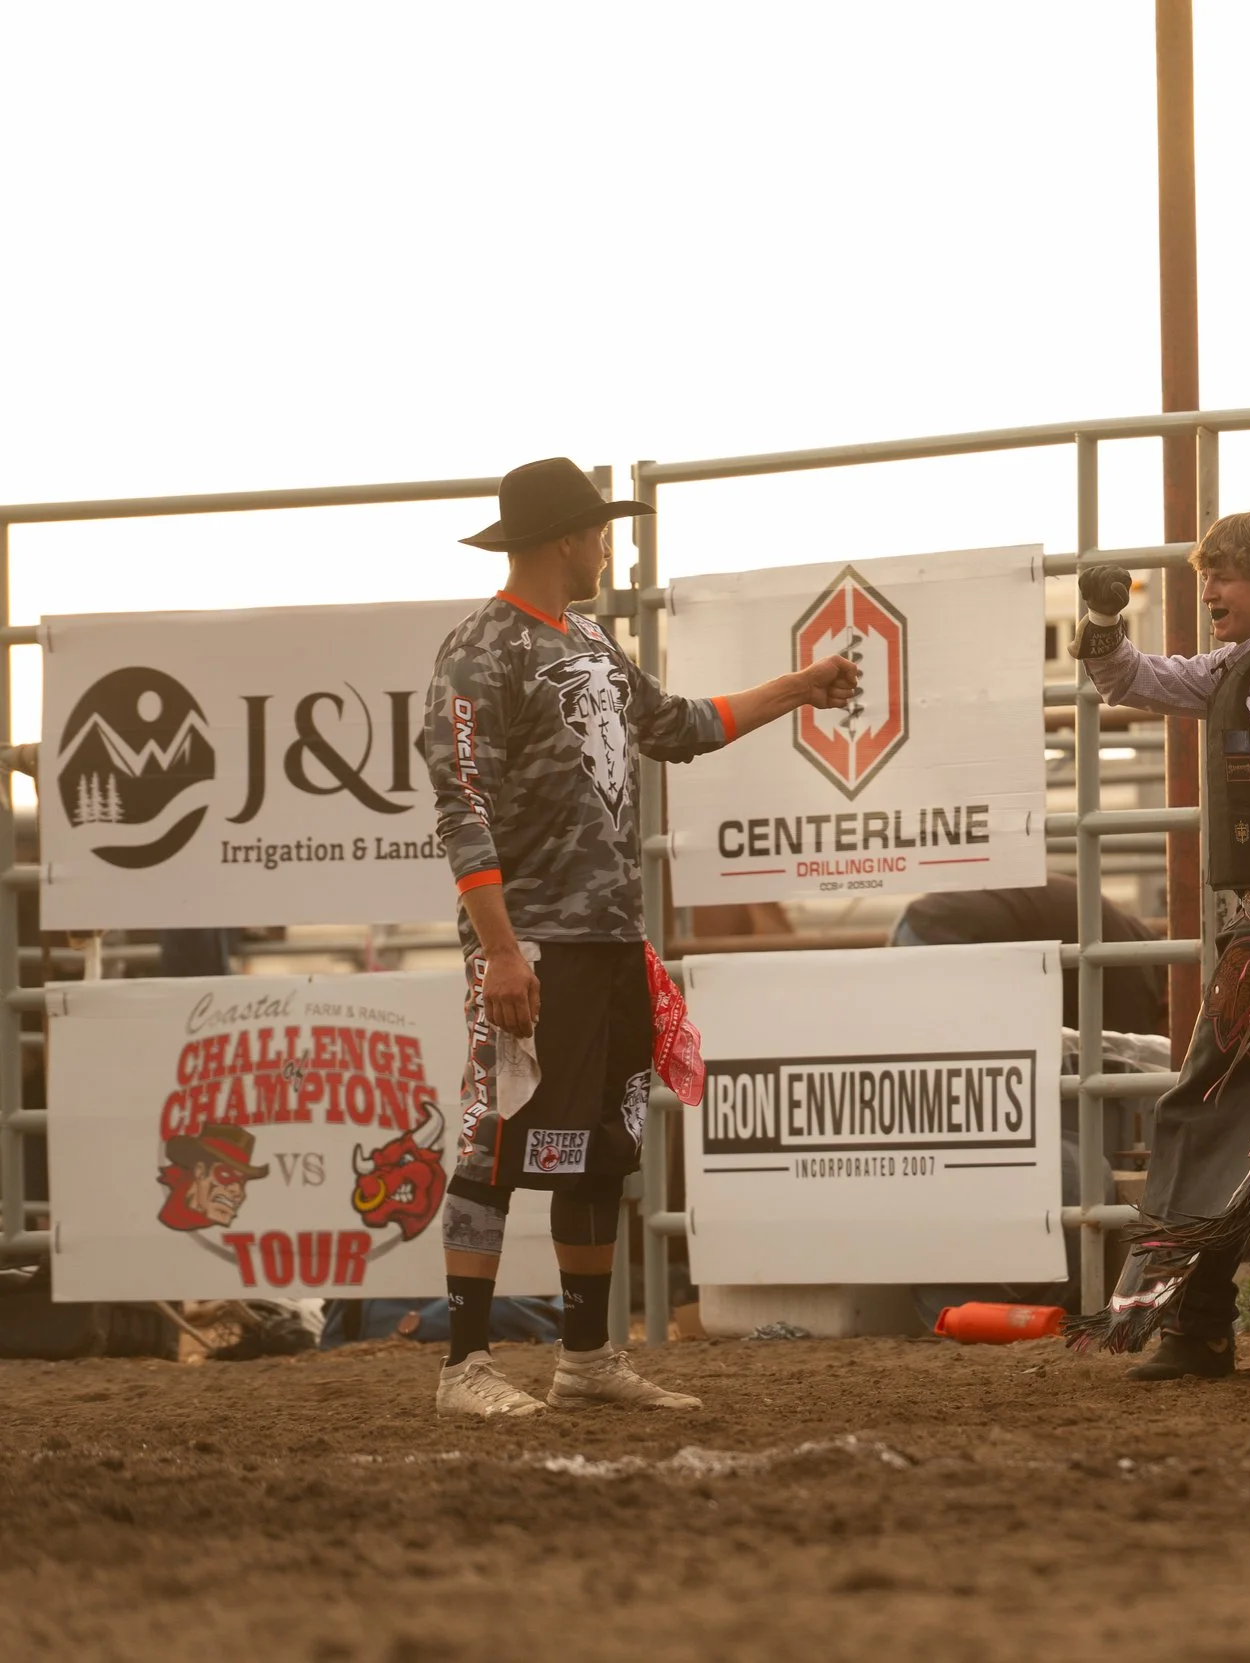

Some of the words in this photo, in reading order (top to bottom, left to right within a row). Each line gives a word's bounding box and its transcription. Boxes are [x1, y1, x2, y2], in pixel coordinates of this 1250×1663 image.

[577, 688, 624, 719] O'NEIL
[454, 697, 479, 783] O'NEIL
[222, 837, 344, 870] Irrigation
[352, 838, 368, 861] &
[718, 804, 989, 859] CENTERLINE
[796, 859, 874, 878] DRILLING
[877, 857, 906, 873] INC
[847, 879, 883, 890] 205304
[185, 989, 298, 1035] Coastal
[304, 1002, 342, 1017] FARM
[345, 1004, 355, 1018] &
[358, 1006, 405, 1026] RANCH
[471, 957, 490, 1049] ONEIL
[176, 1025, 427, 1087] CHALLENGE
[282, 1049, 308, 1093] of
[160, 1070, 438, 1143] CHAMPIONS
[462, 1059, 488, 1154] ARENA
[707, 1073, 775, 1140] IRON
[788, 1065, 1023, 1137] ENVIRONMENTS
[273, 1152, 326, 1187] VS
[796, 1156, 895, 1178] INCORPORATED
[902, 1156, 935, 1176] 2007
[220, 1229, 373, 1288] TOUR
